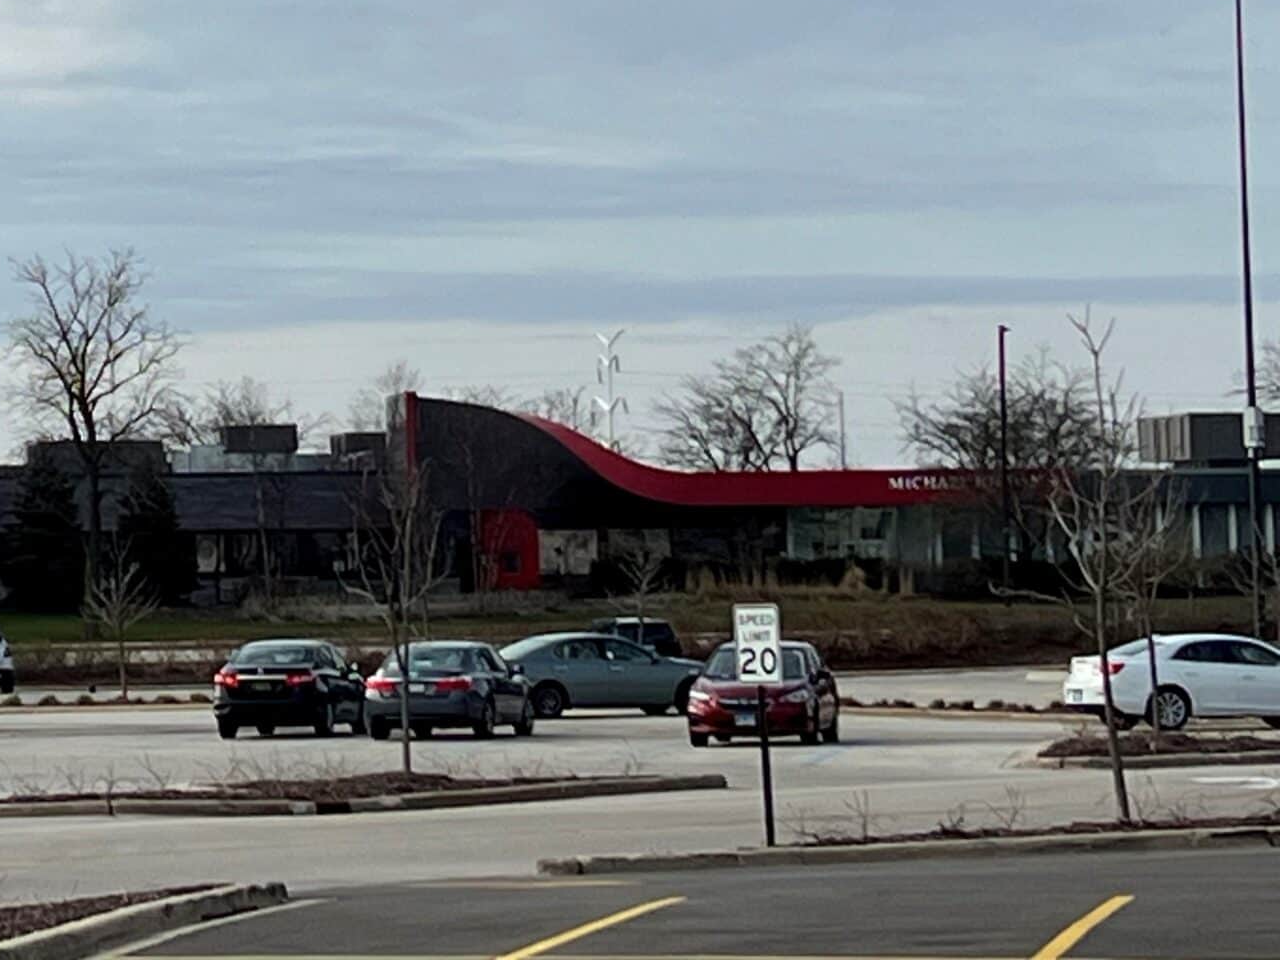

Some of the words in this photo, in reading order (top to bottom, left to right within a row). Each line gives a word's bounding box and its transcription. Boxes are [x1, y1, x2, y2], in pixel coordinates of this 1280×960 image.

[888, 476, 968, 490] MICHA
[739, 614, 774, 626] SPEED
[740, 648, 777, 675] 20
